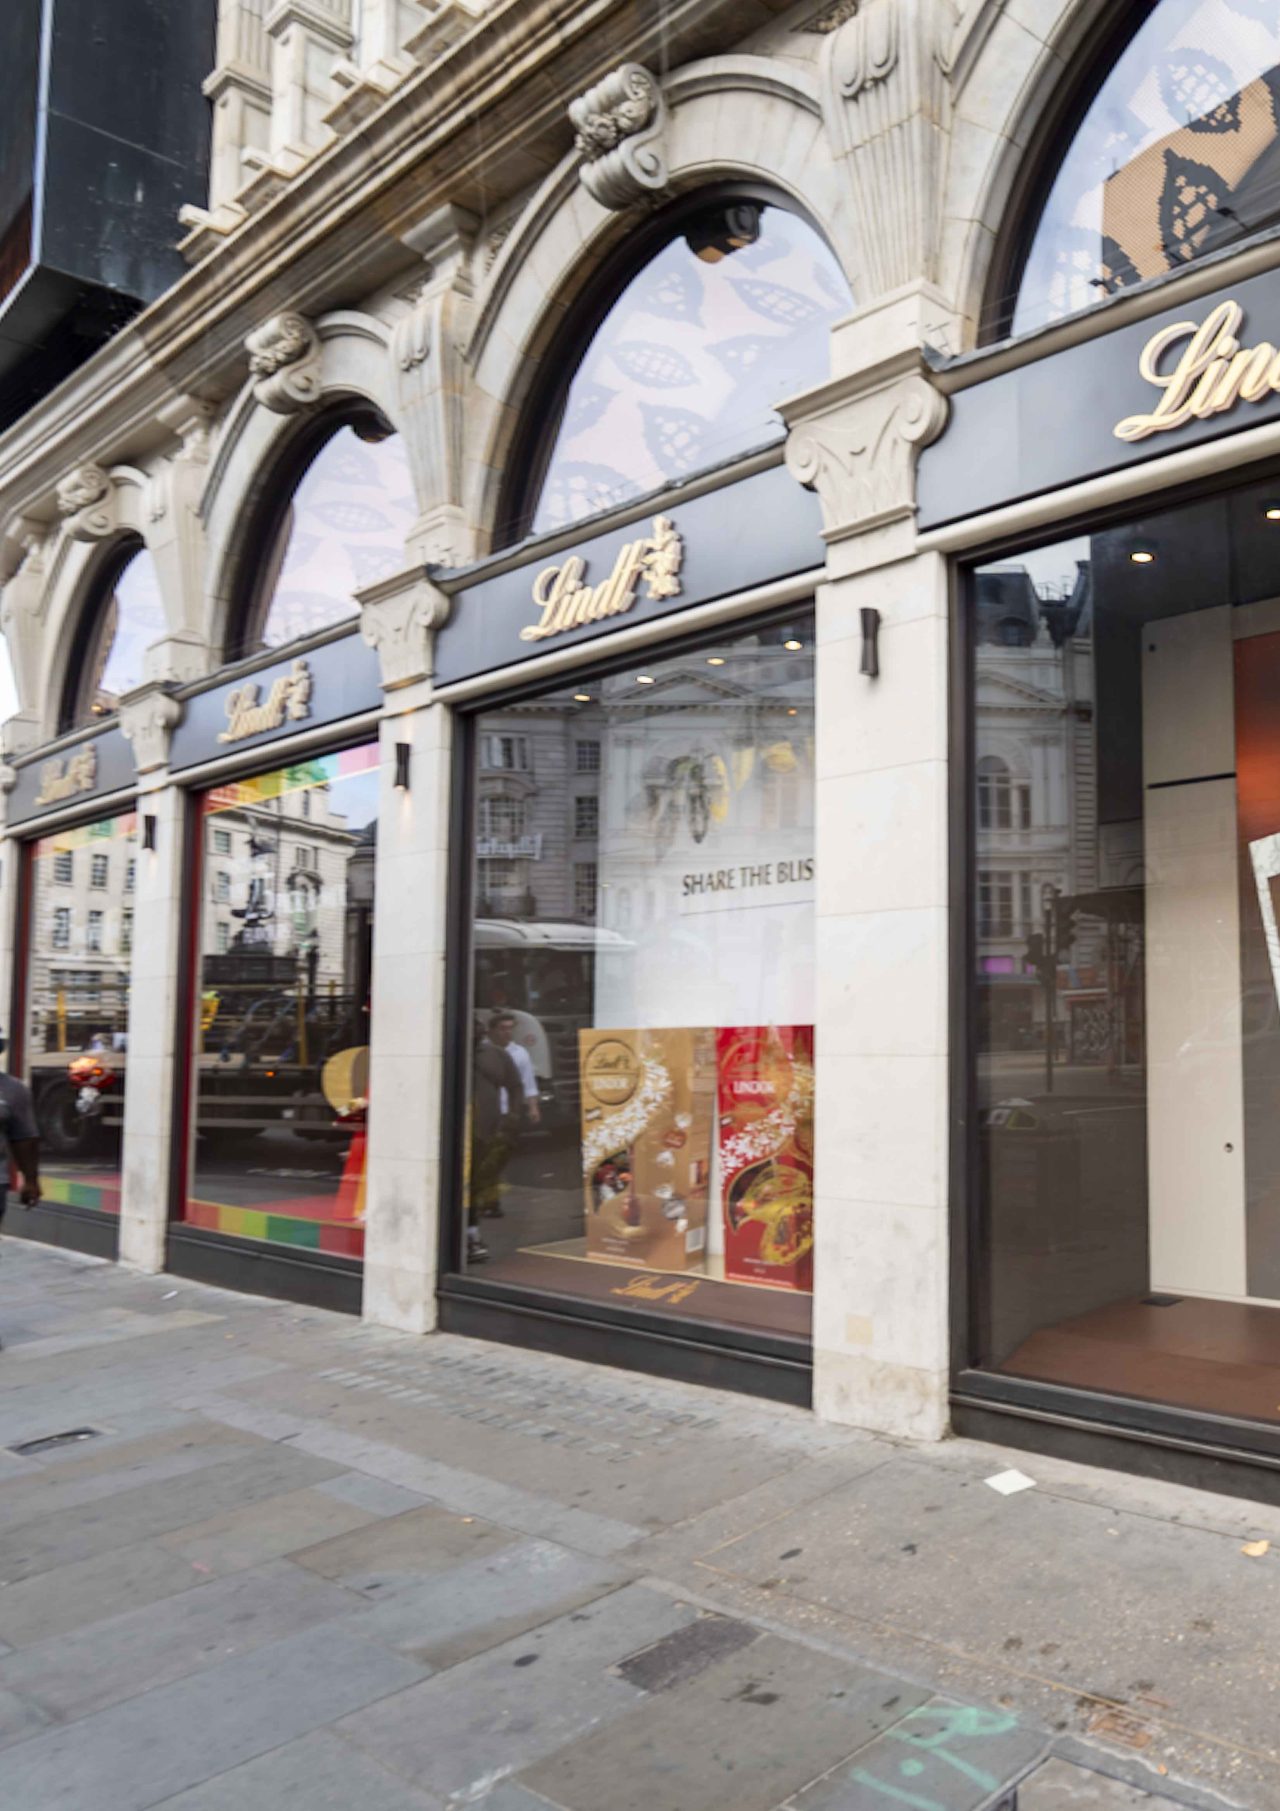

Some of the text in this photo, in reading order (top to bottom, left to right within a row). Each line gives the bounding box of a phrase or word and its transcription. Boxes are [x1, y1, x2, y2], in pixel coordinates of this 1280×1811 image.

[519, 538, 647, 641] Lindt
[217, 676, 293, 744] Lindt
[682, 868, 736, 896] SHARE
[739, 863, 772, 888] THE
